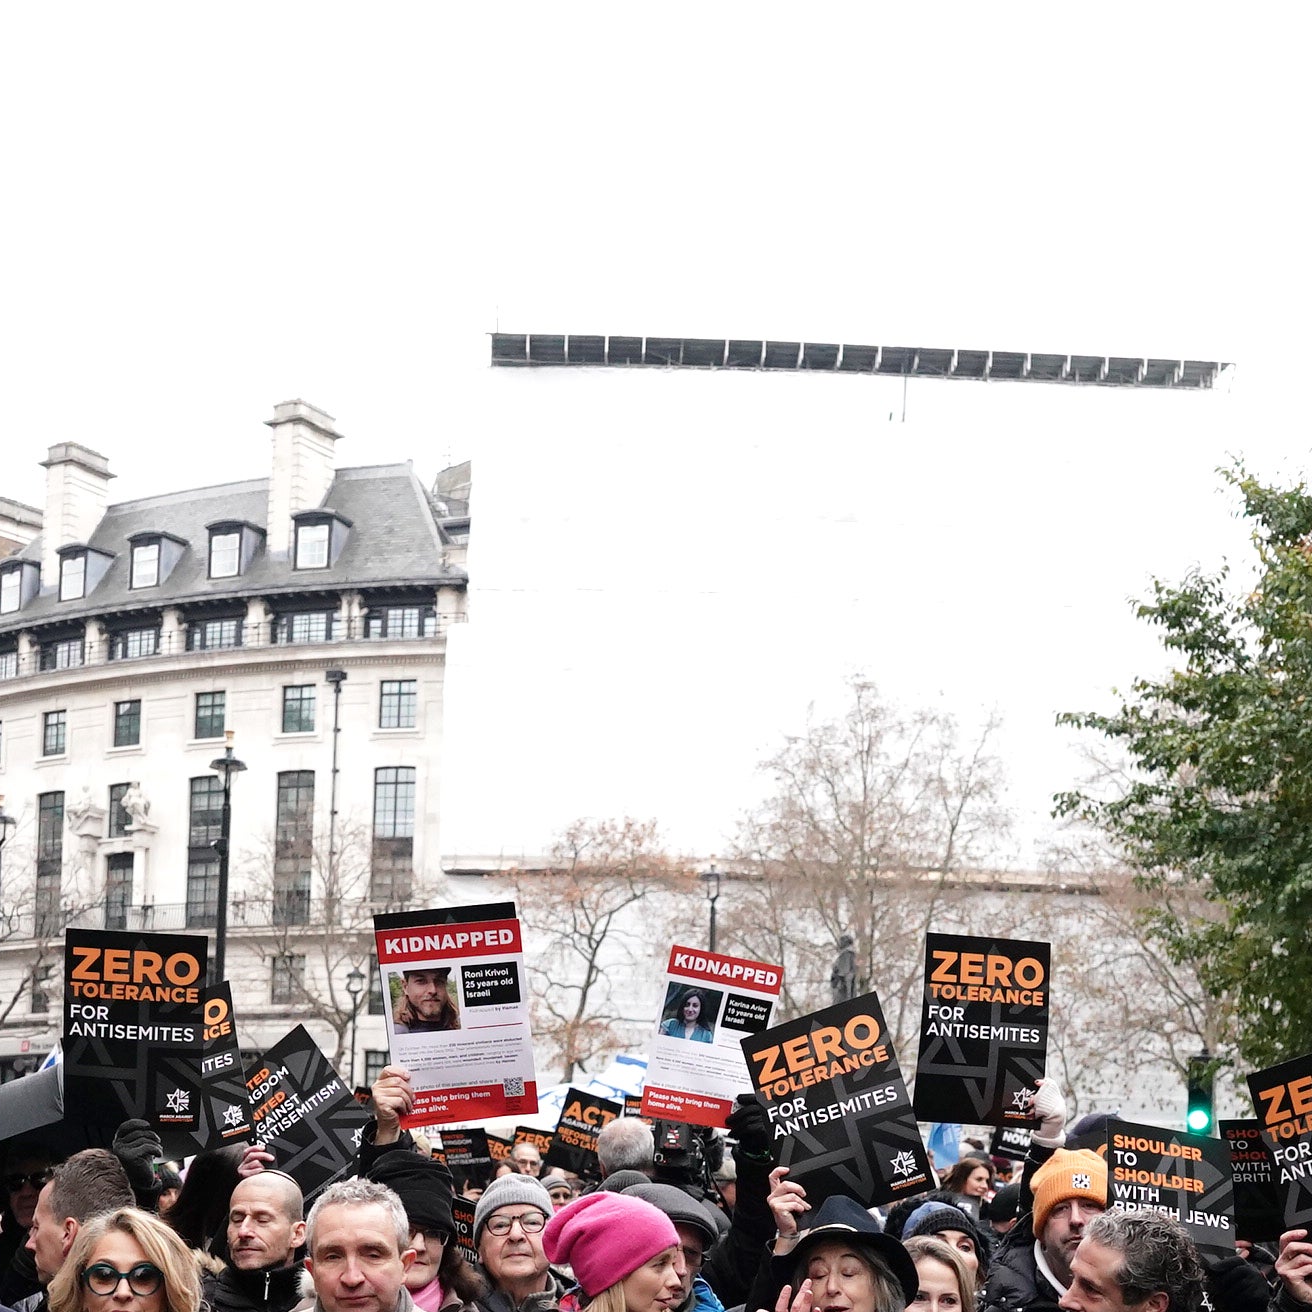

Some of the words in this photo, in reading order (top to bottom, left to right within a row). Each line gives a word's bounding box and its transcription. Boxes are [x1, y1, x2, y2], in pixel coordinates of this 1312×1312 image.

[385, 928, 514, 954] KIDNAPPED
[71, 946, 200, 986] ZERO
[464, 970, 483, 979] Roni
[674, 953, 777, 986] KIDNAPPED
[930, 950, 1044, 990] ZERO
[70, 981, 199, 1004] TOLERANCE
[465, 980, 475, 988] 25
[477, 980, 499, 989] years
[500, 977, 513, 985] old
[466, 989, 491, 998] Israeli
[929, 983, 1044, 1006] TOLERANCE
[70, 1004, 109, 1021] FOR
[728, 1007, 735, 1015] 19
[736, 1010, 753, 1018] years
[729, 999, 750, 1009] Karina
[928, 1005, 965, 1021] FOR
[725, 1015, 745, 1024] Israeli
[69, 1022, 194, 1042] ANTISEMITES
[926, 1023, 1040, 1043] ANTISEMITES
[752, 1014, 880, 1085] ZERO
[245, 1067, 270, 1090] TED
[760, 1044, 889, 1101] TOLERANCE
[431, 1095, 448, 1103] help
[449, 1092, 470, 1101] bring
[648, 1099, 665, 1108] home
[666, 1102, 682, 1111] alive.
[649, 1091, 669, 1100] Please
[670, 1095, 684, 1104] help
[685, 1098, 702, 1107] bring
[703, 1100, 720, 1109] them
[256, 1093, 300, 1134] GAINST
[256, 1080, 341, 1147] ANTISEMITISM
[564, 1100, 616, 1125] ACT
[767, 1097, 807, 1123] FOR
[774, 1086, 898, 1140] ANTISEMITES
[558, 1126, 591, 1141] BEFORE
[561, 1117, 592, 1131] AGAINST
[561, 1135, 579, 1146] TOO
[1002, 1131, 1031, 1147] NOW
[1113, 1134, 1202, 1162] SHOULDER
[1229, 1141, 1248, 1150] TO
[1114, 1150, 1137, 1166] TO
[1273, 1142, 1312, 1166] FOR
[1231, 1162, 1271, 1172] WITH
[1113, 1167, 1204, 1194] SHOULDER
[1232, 1173, 1271, 1183] BRITI
[1114, 1183, 1160, 1203] WITH
[455, 1220, 467, 1234] TO
[1185, 1209, 1230, 1230] JEWS
